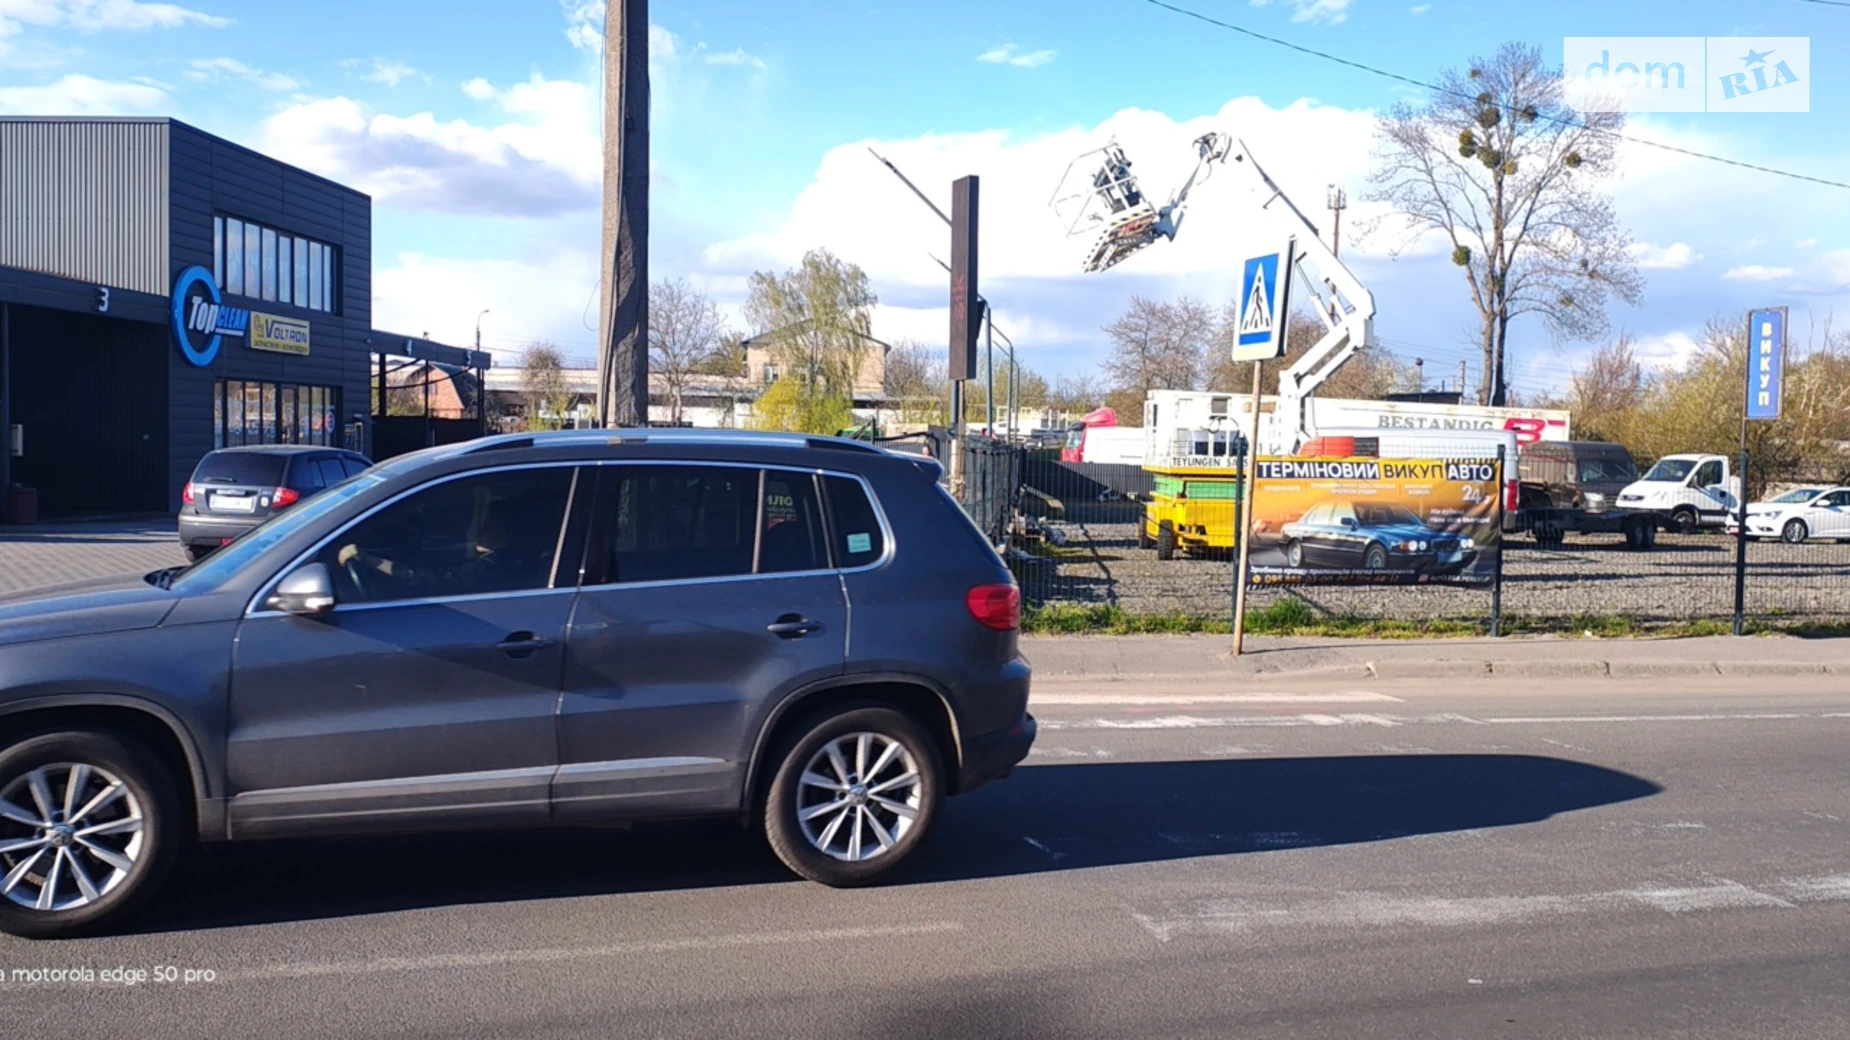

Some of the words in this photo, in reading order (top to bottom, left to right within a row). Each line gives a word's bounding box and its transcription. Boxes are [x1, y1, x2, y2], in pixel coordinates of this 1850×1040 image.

[98, 286, 109, 312] 3
[1758, 322, 1772, 407] ВИКУП
[1172, 457, 1221, 467] TEYLINGEN
[1258, 461, 1379, 478] ТЕРМІНОВИЙ
[1384, 464, 1443, 479] ВИКУП
[1448, 465, 1493, 480] АВТО
